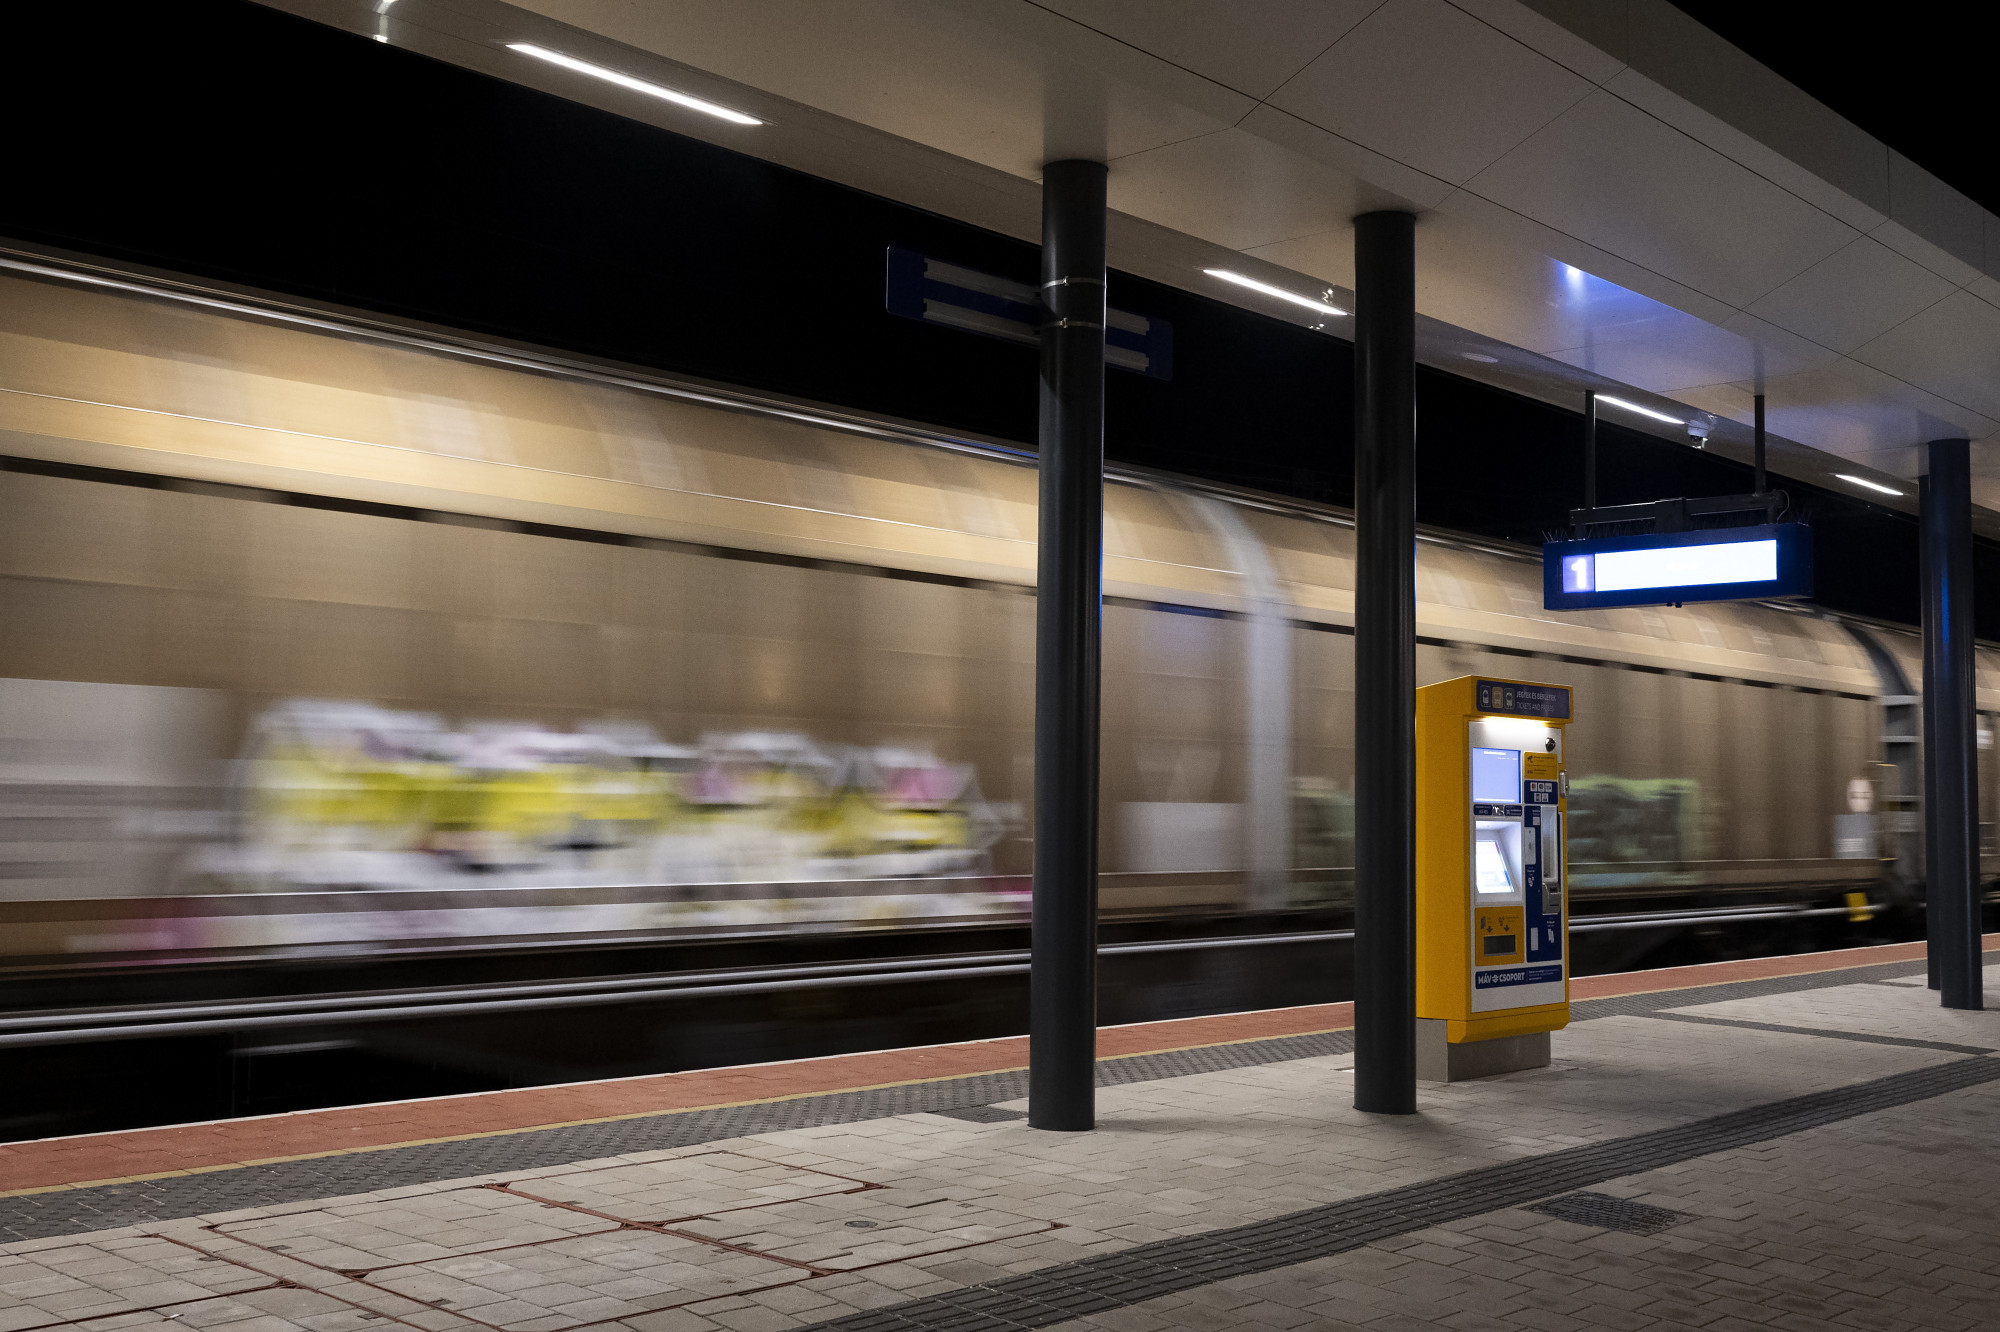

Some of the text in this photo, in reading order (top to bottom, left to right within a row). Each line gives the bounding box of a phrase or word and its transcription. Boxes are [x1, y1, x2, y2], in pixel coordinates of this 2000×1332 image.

[1571, 557, 1588, 589] 1
[1478, 973, 1492, 984] MÁV
[1499, 972, 1525, 982] CSOPORT
